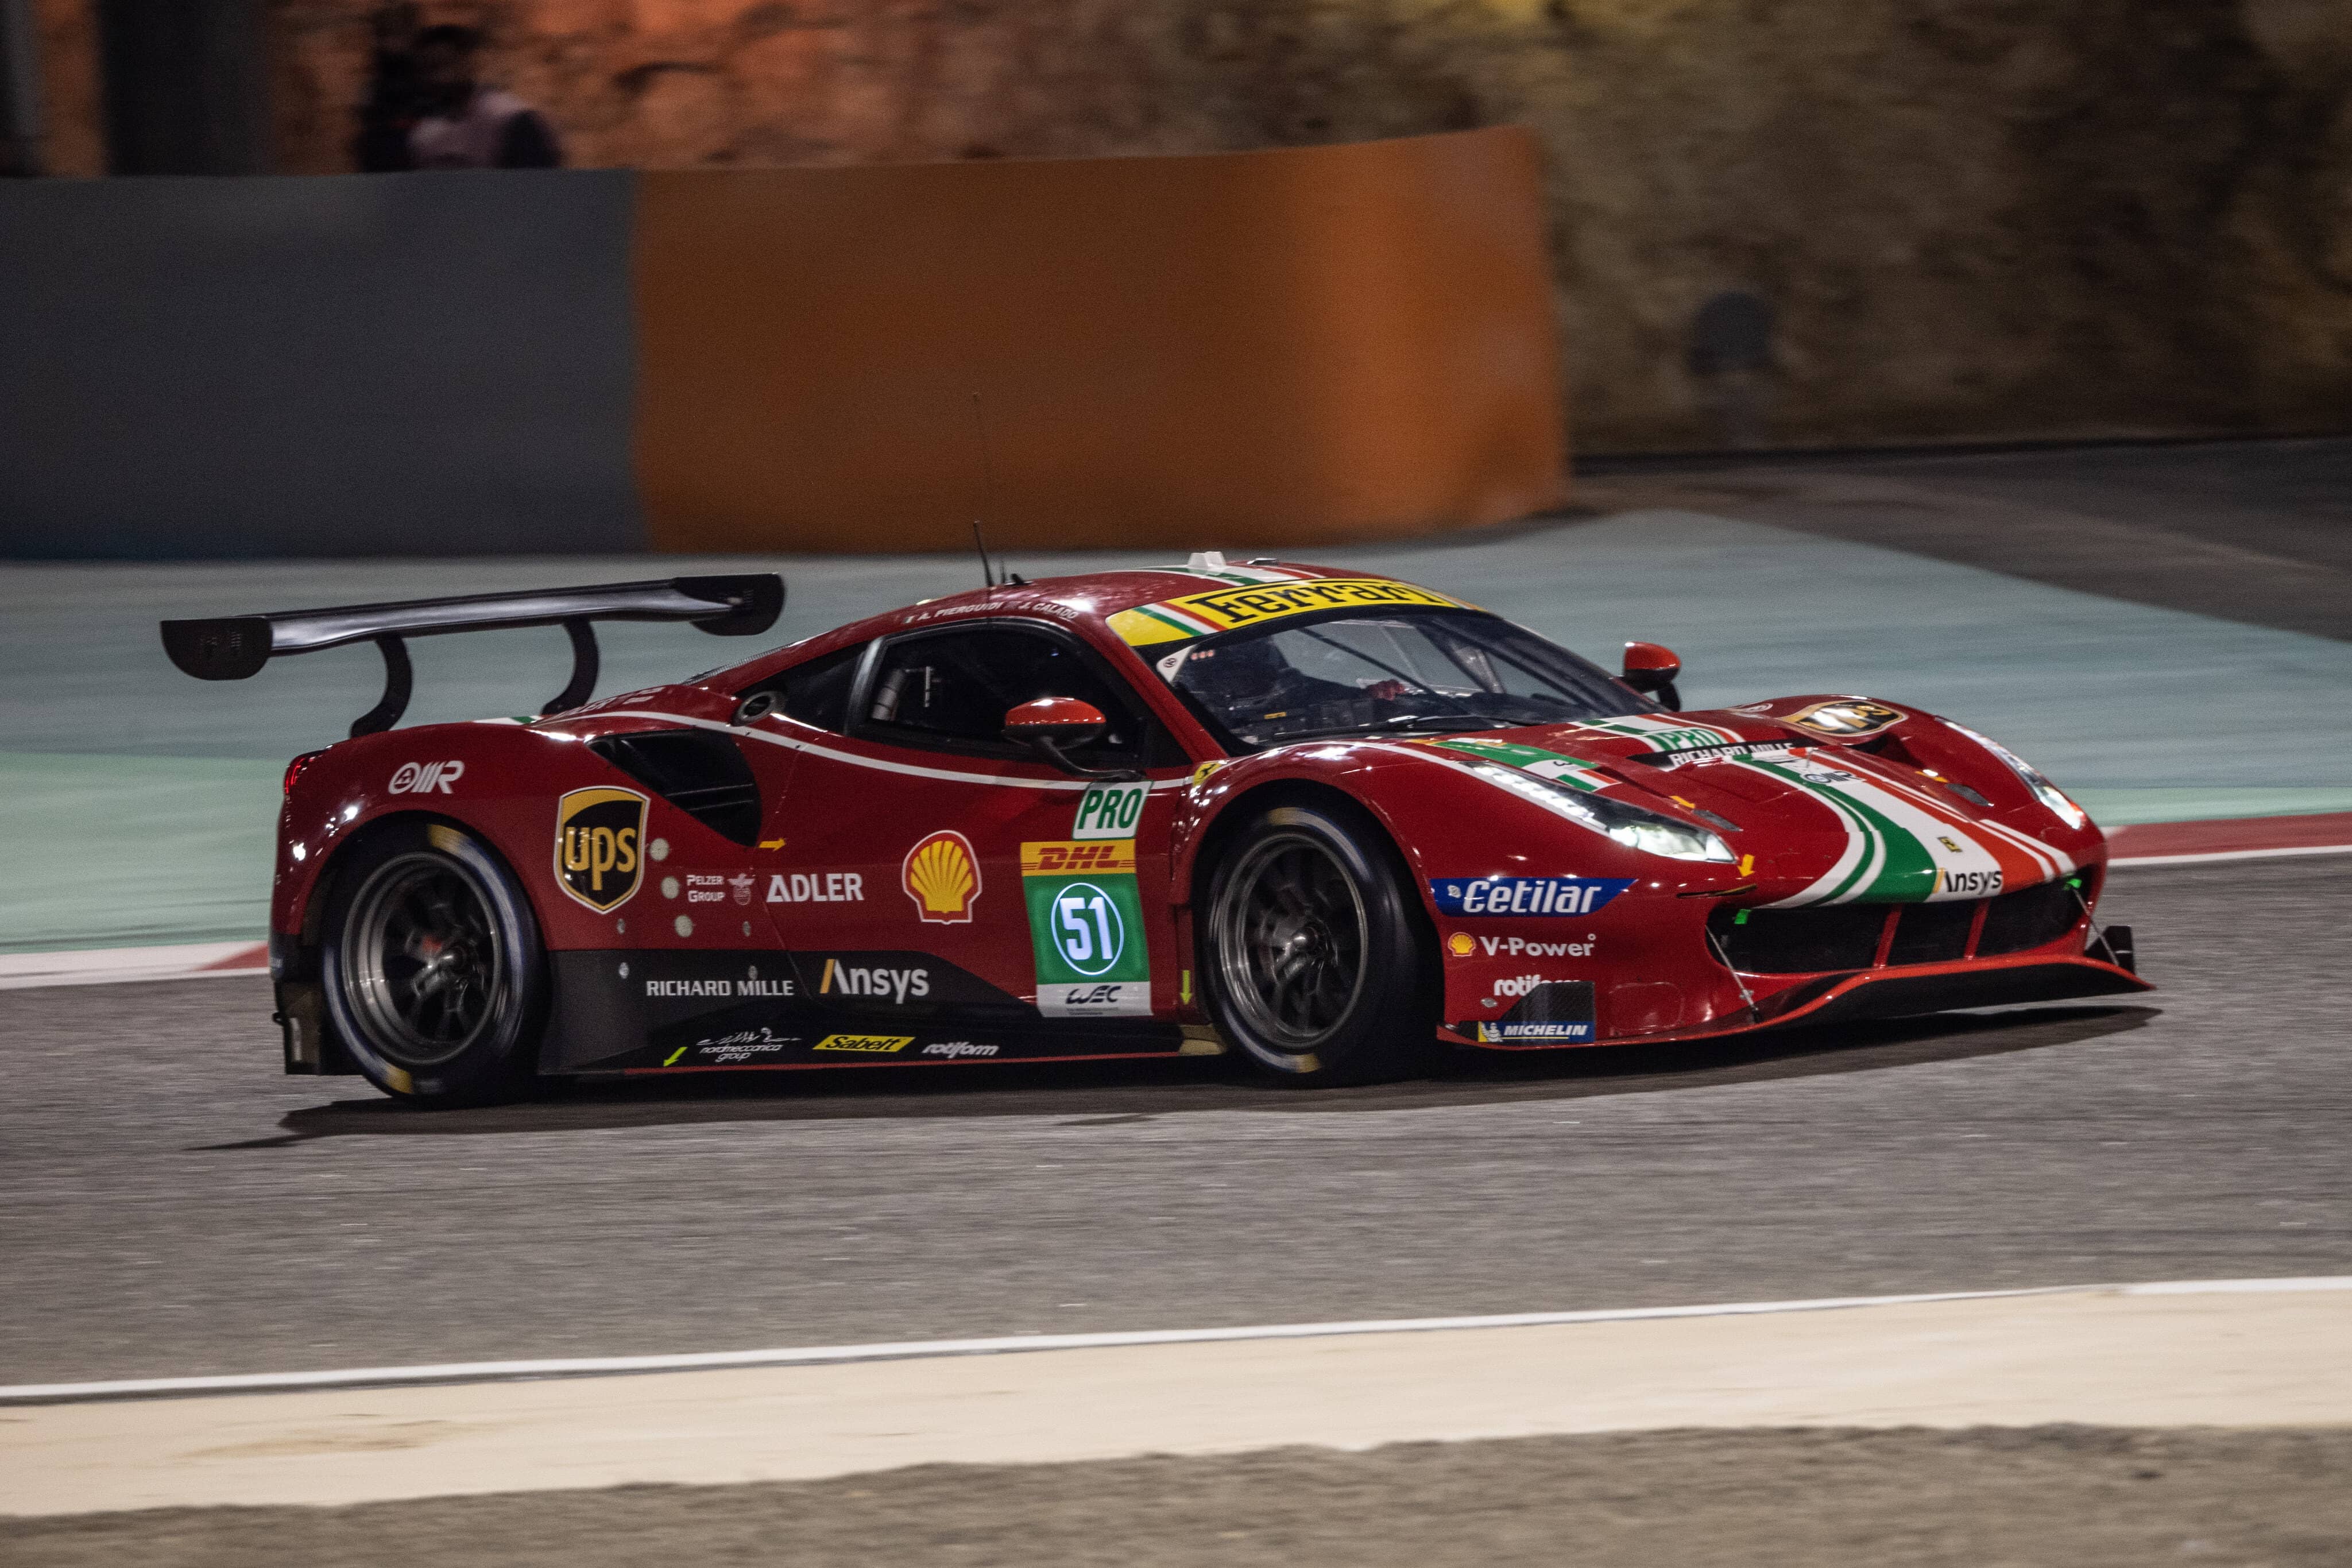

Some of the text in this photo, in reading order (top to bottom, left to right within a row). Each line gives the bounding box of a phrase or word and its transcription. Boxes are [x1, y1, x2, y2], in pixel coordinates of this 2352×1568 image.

[934, 601, 1005, 617] PIERGUIDI
[1032, 603, 1079, 620] CALADO
[1186, 579, 1444, 624] Ferrari
[1077, 788, 1142, 829] PRO
[564, 826, 637, 891] ups
[1037, 846, 1119, 870] DHL
[766, 873, 865, 903] ADLER
[1463, 880, 1602, 913] Cetilar
[1059, 897, 1113, 960] 51
[645, 980, 795, 996] RICHARD MILLE
[819, 959, 930, 1004] Ansys
[1065, 985, 1122, 1005] WEC
[1503, 1025, 1588, 1036] MICHELIN
[826, 1036, 902, 1051] Sabelt
[921, 1042, 1000, 1059] rotiform
[715, 1052, 752, 1063] group
